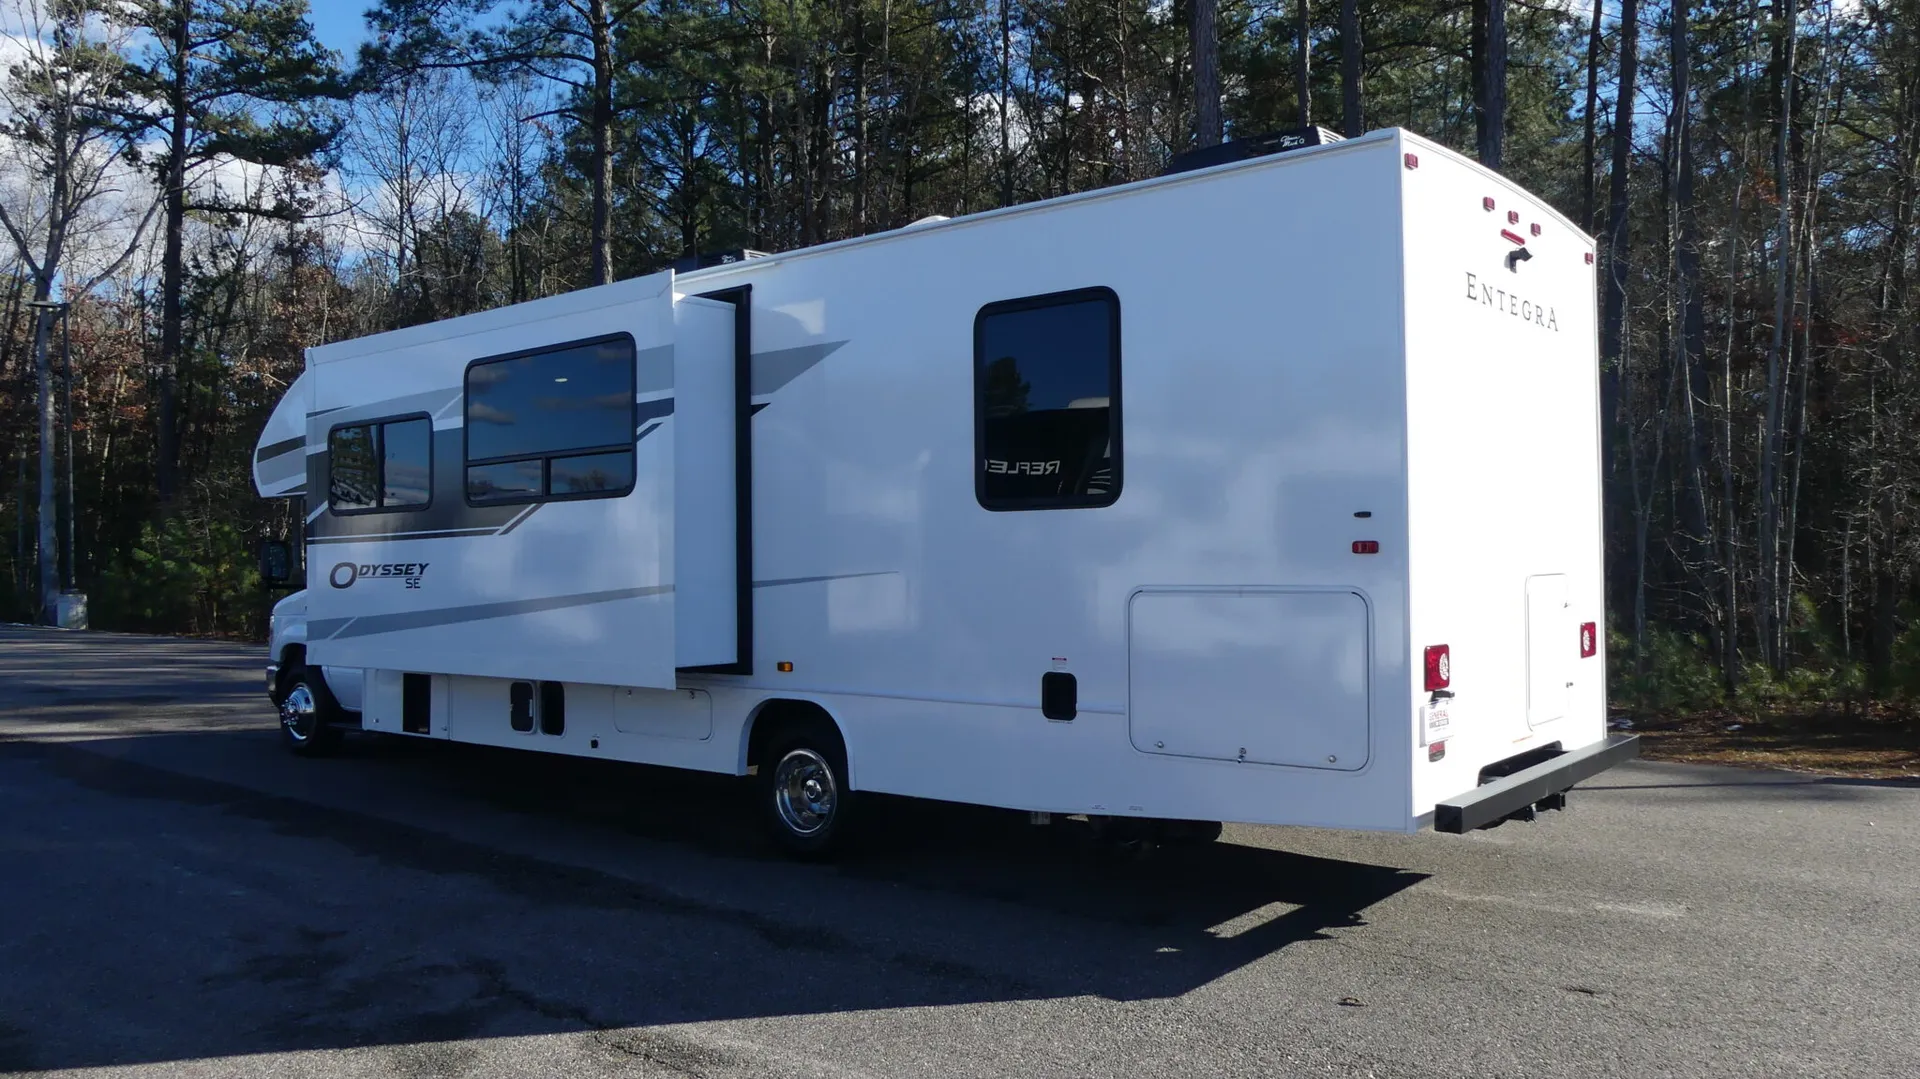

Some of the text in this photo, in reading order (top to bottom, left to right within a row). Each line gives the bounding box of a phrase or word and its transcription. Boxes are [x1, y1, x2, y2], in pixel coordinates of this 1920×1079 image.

[1465, 271, 1559, 332] ENTEGRA
[330, 562, 430, 589] ODYSSEY
[405, 577, 421, 589] SE
